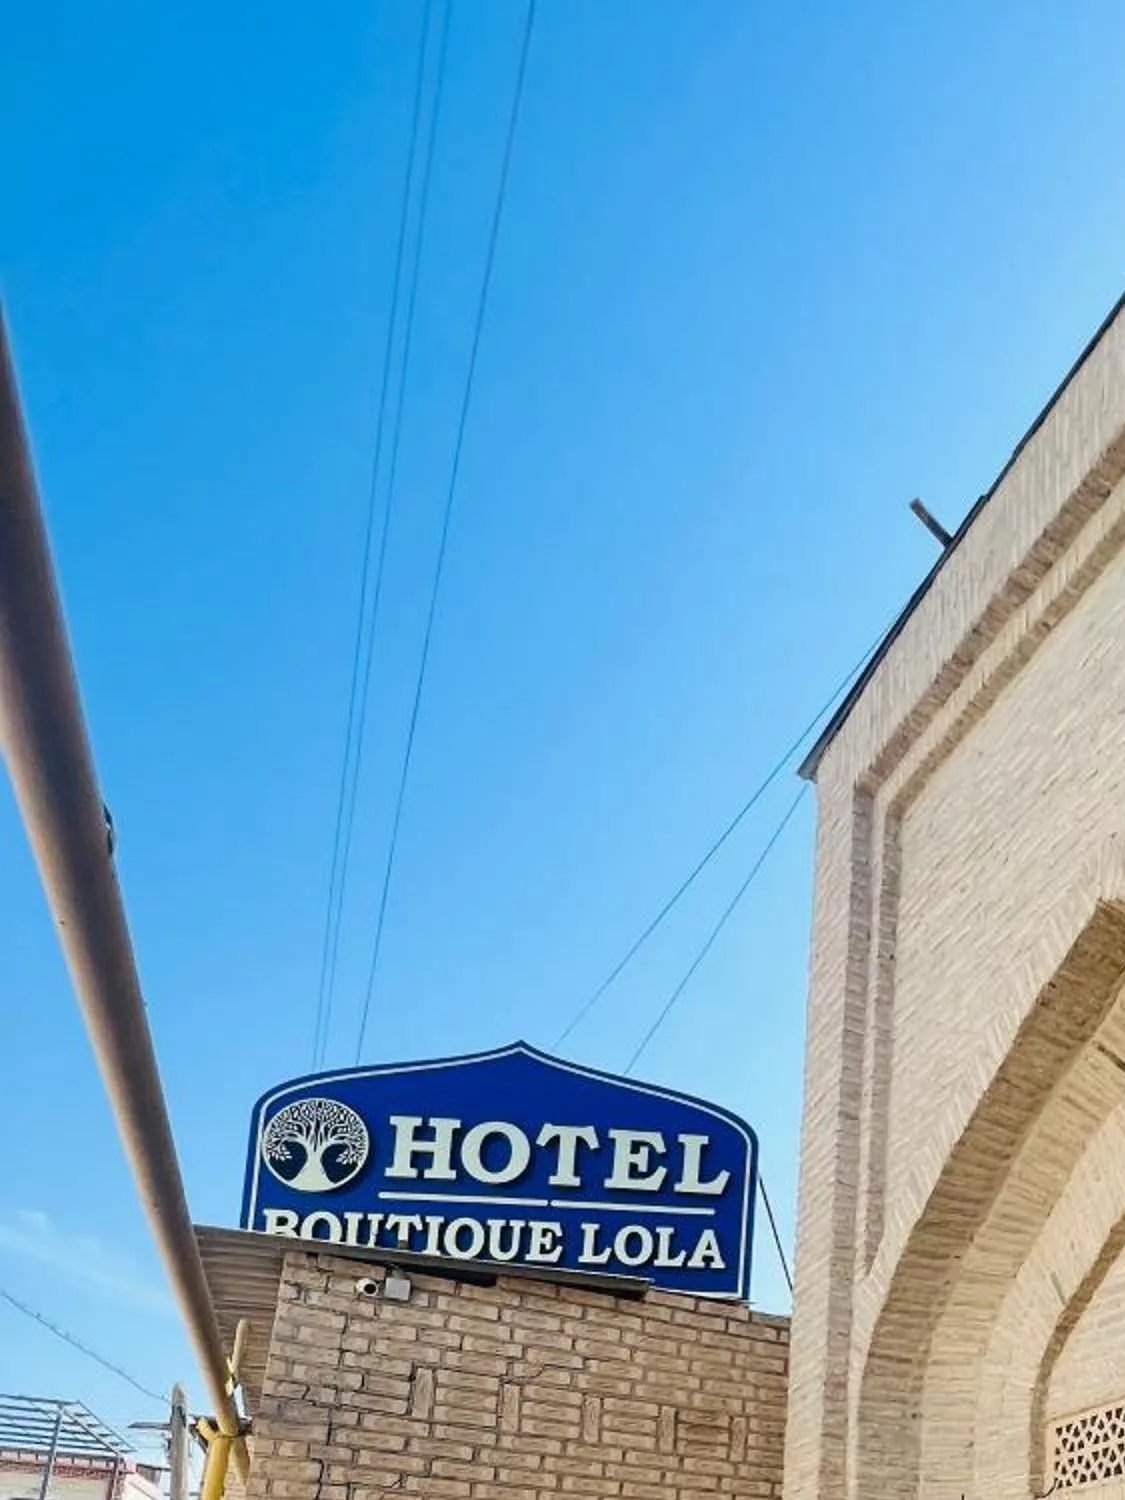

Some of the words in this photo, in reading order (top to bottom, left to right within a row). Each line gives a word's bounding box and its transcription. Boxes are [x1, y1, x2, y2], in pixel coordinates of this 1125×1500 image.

[384, 1115, 730, 1195] HOTEL
[263, 1208, 564, 1263] BOUTIQUE
[579, 1223, 726, 1269] LOLA
